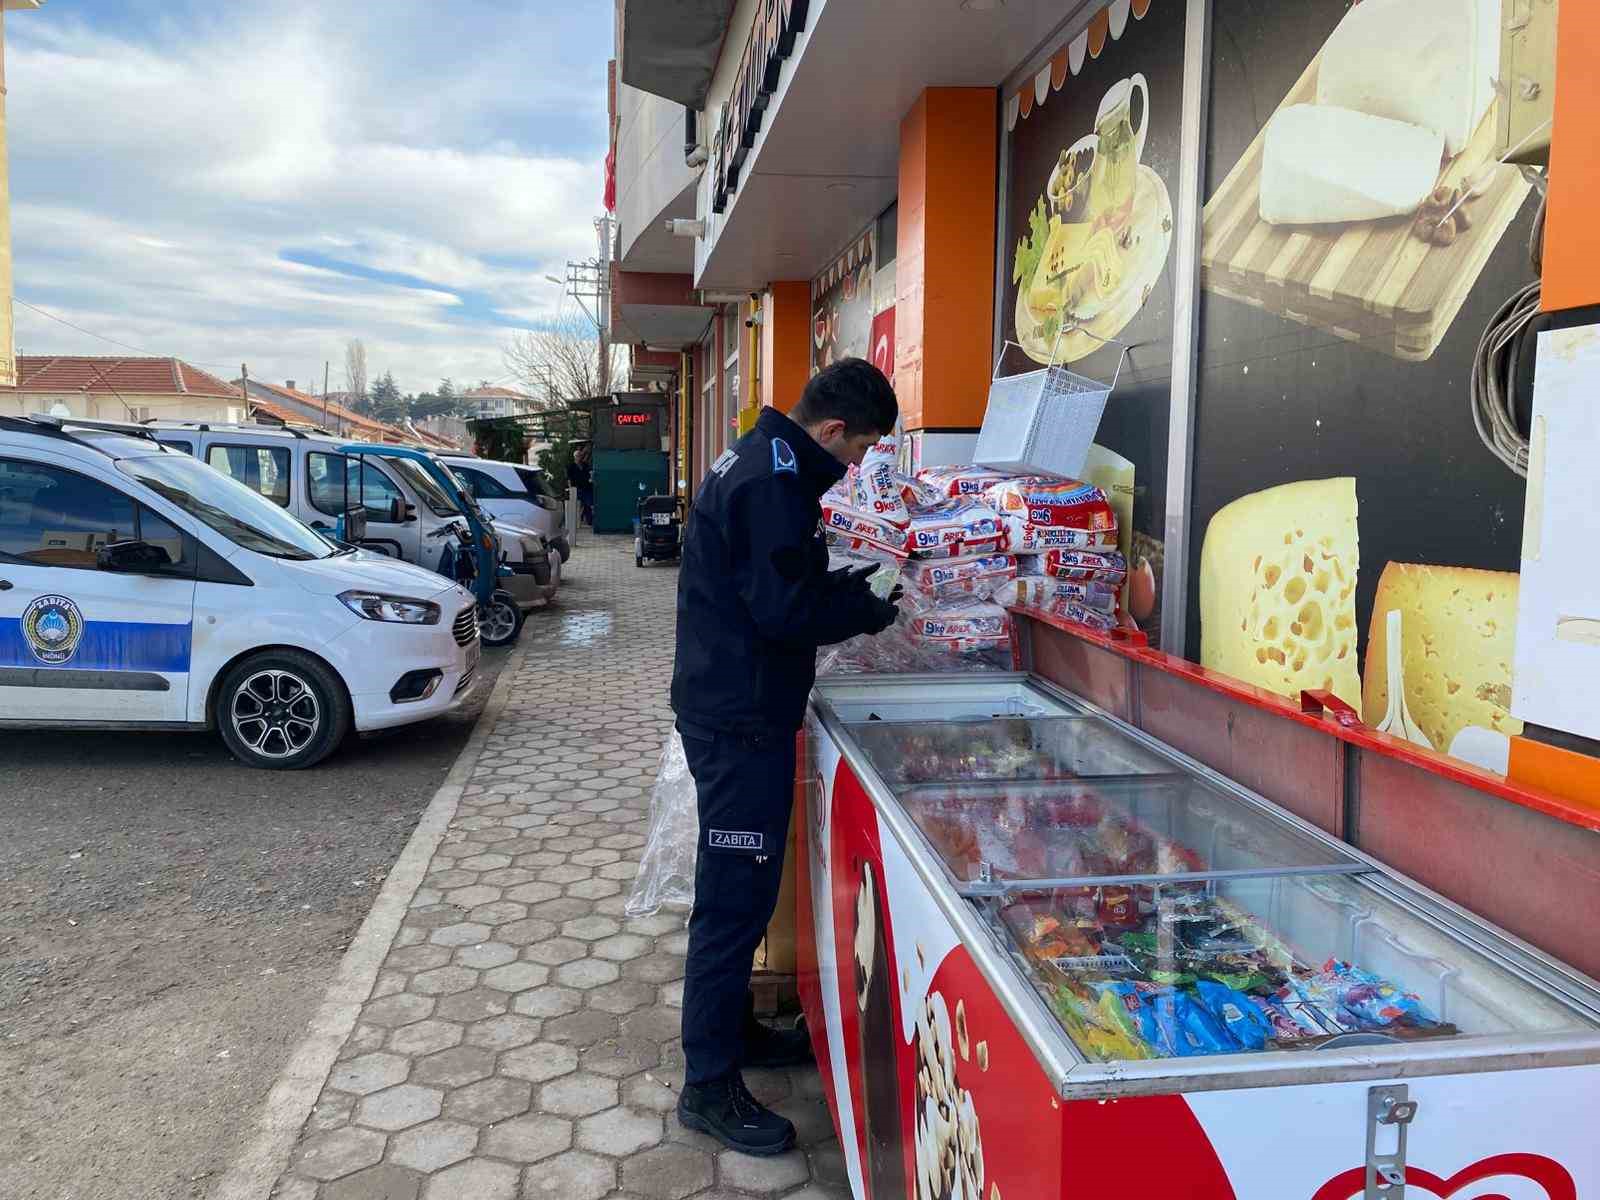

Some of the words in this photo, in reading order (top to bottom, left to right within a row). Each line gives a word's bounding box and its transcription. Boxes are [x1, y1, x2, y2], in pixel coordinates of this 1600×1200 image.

[618, 414, 631, 424] ÇAY
[960, 481, 979, 493] 9kg
[874, 500, 895, 513] 9kg
[1032, 509, 1051, 525] 9KG
[832, 512, 852, 530] 9kg
[855, 523, 878, 538] AREX
[918, 532, 938, 546] 9kg
[943, 531, 966, 543] AREX
[933, 569, 954, 583] 9kg
[926, 621, 945, 634] 9kg
[715, 833, 756, 846] ZABITA
